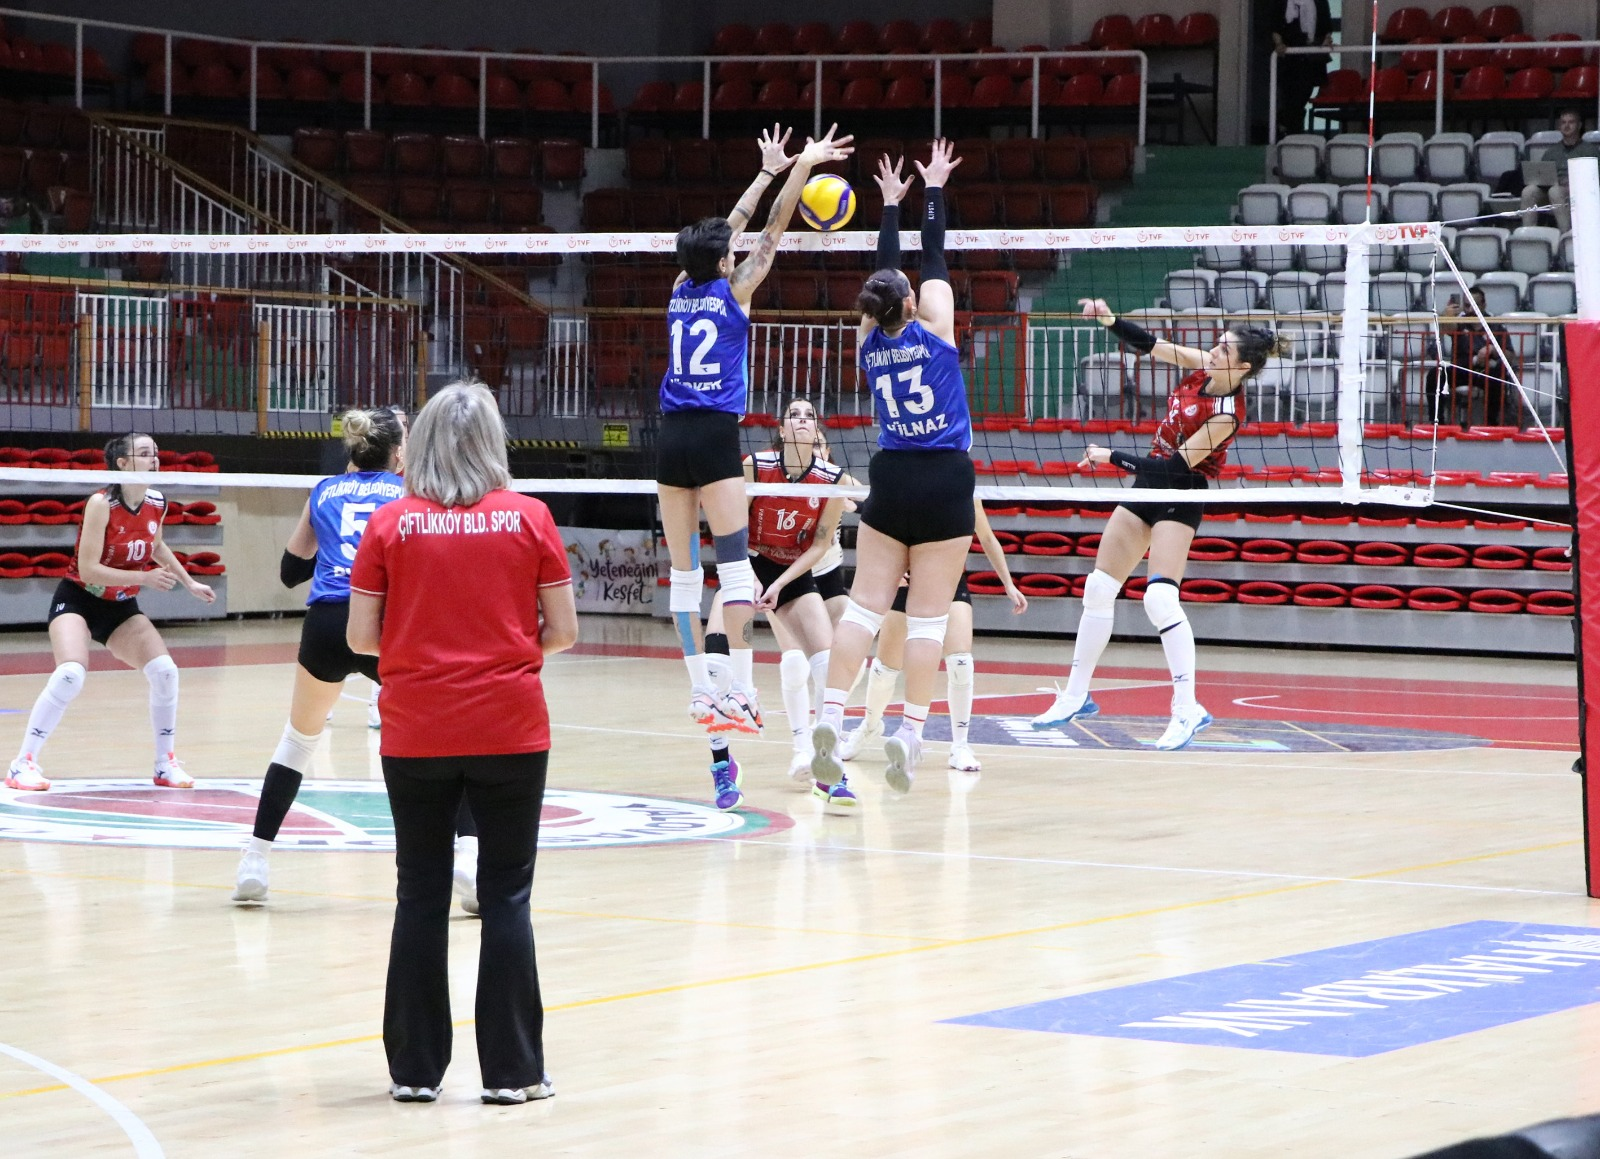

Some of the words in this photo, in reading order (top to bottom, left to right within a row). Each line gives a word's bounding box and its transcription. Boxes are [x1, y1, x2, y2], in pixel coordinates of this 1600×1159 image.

[1398, 225, 1428, 239] TVF
[671, 319, 720, 375] 12
[876, 365, 935, 418] 13
[340, 503, 376, 560] 5
[399, 508, 461, 541] ÇİFTLİKKÖY
[464, 513, 489, 534] BLD.
[491, 510, 521, 533] SPOR
[777, 509, 799, 530] 16
[126, 540, 146, 561] 10
[589, 558, 658, 585] Yeteneğini
[604, 581, 654, 605] Keşfet
[1118, 948, 1600, 1038] HALKBANK
